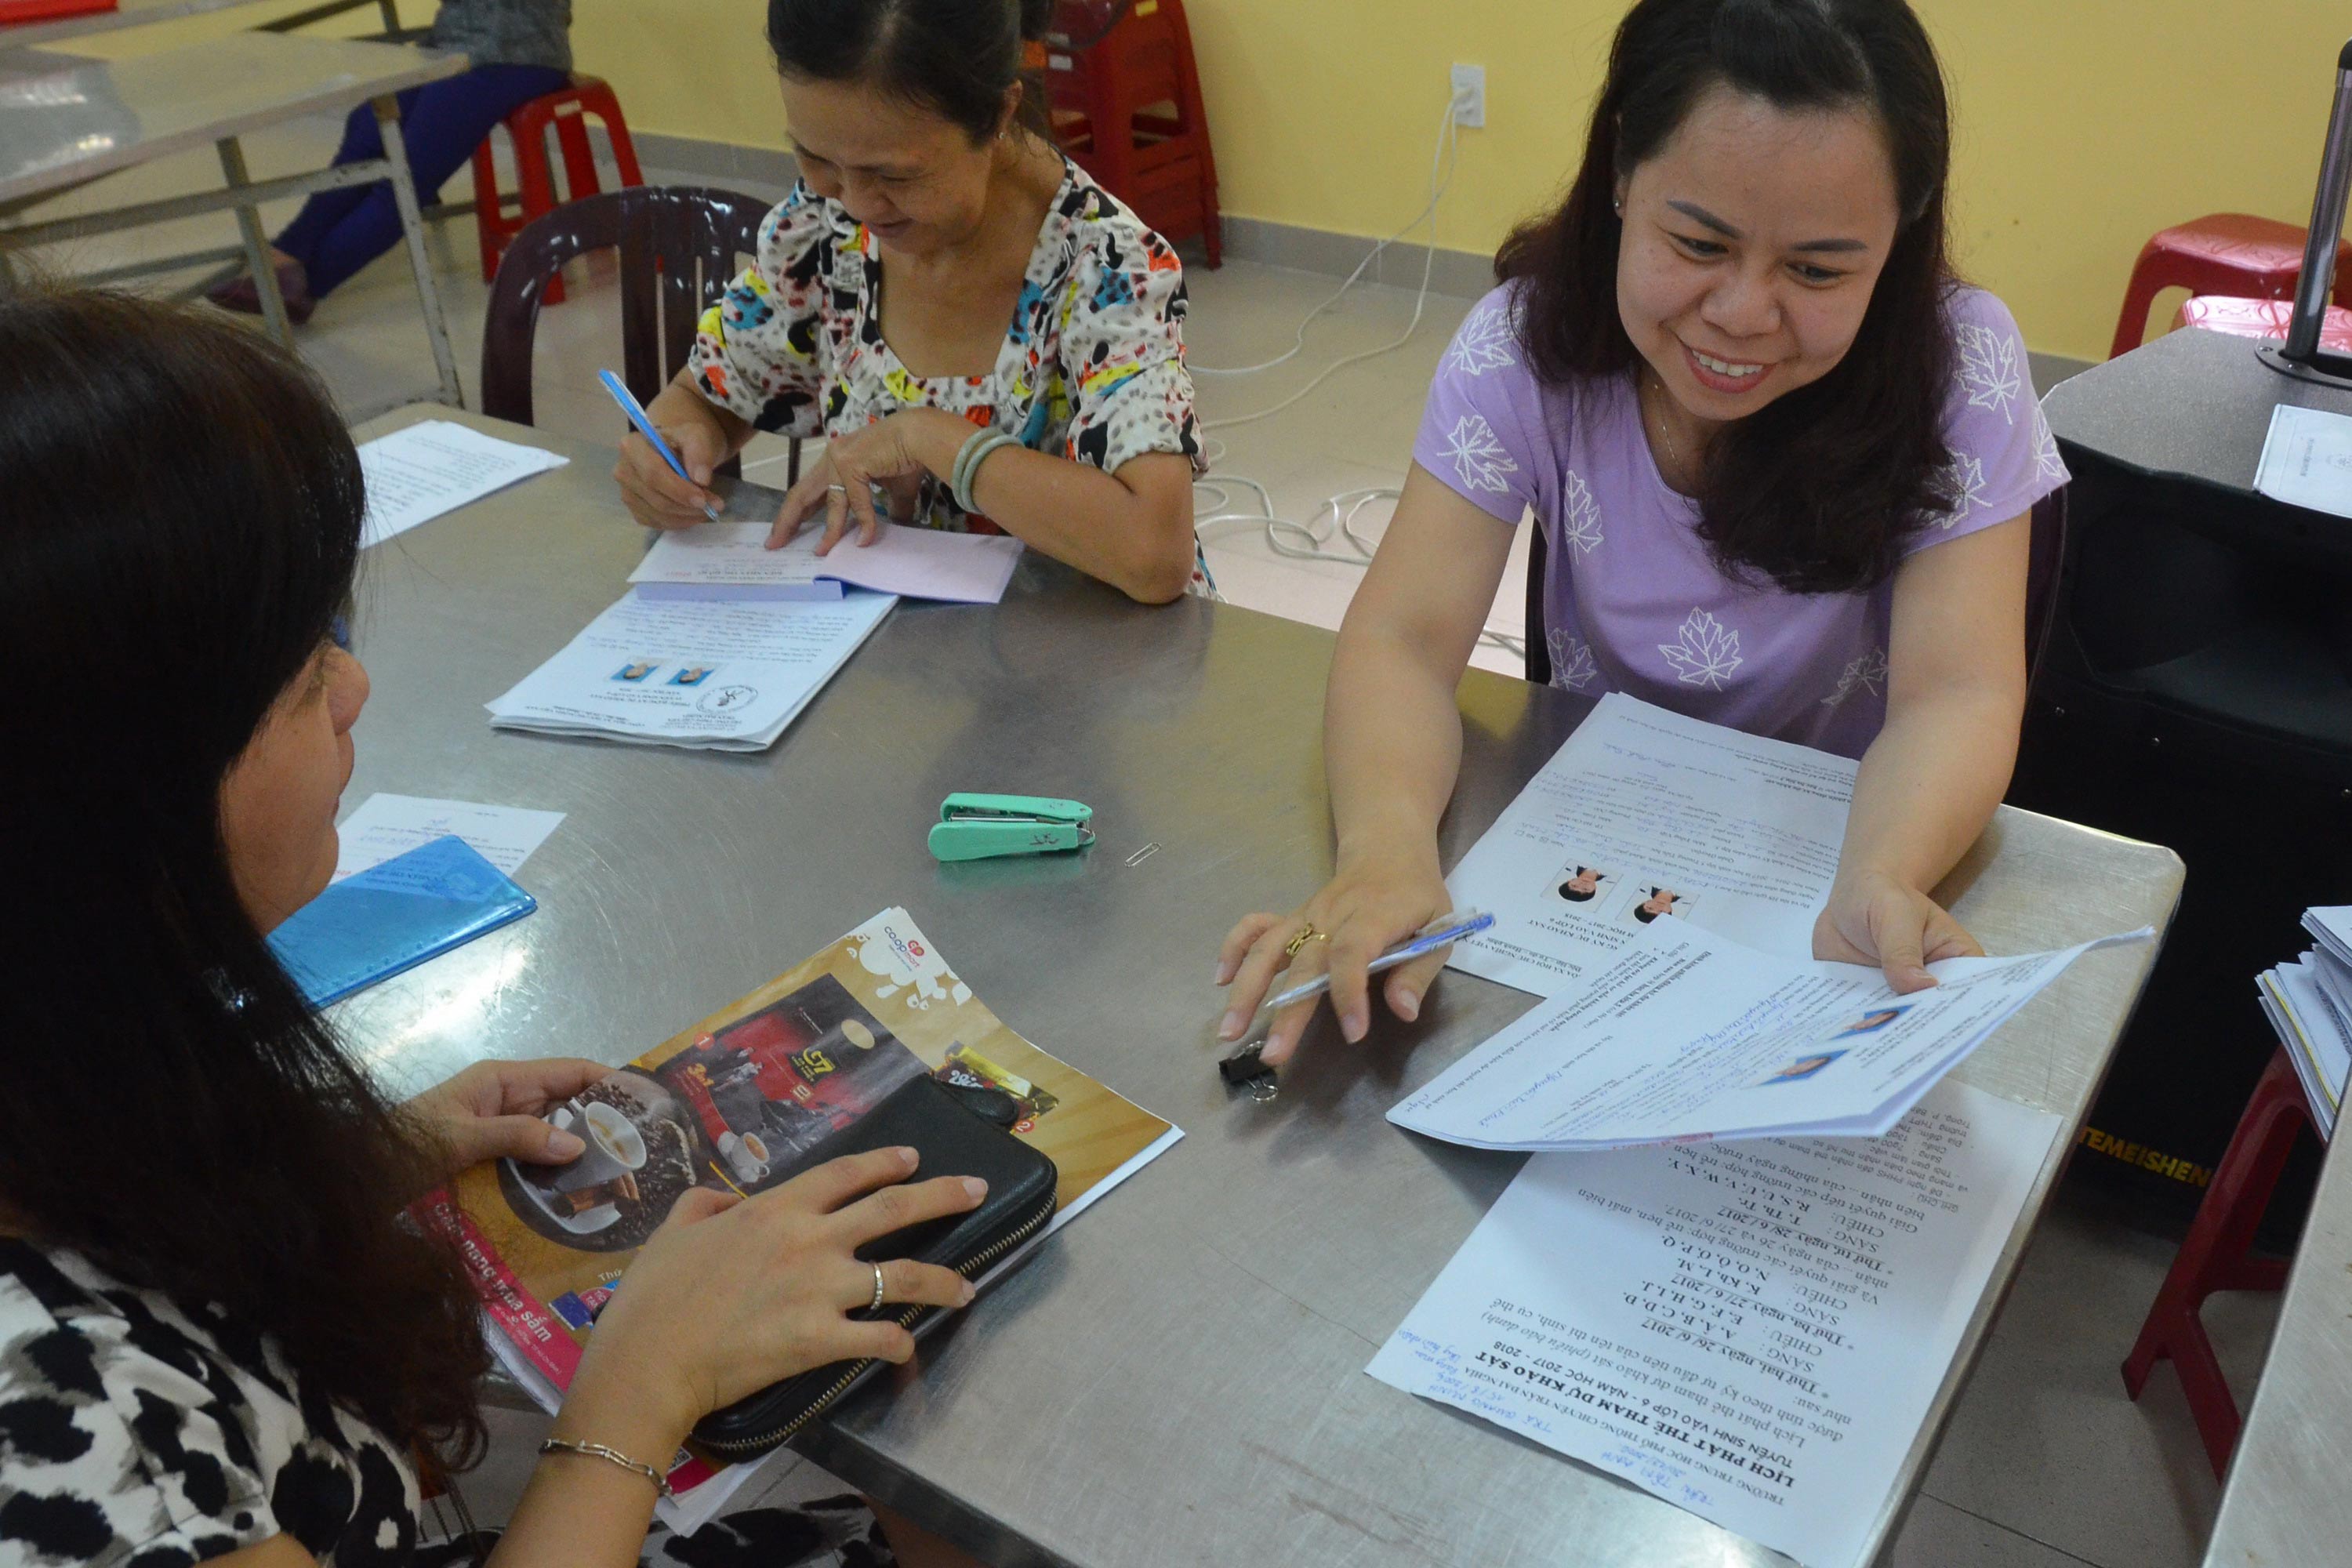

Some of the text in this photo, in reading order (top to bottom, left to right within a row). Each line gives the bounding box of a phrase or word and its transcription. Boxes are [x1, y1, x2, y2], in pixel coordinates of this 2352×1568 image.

[2078, 1126, 2213, 1188] TEMEISHEN
[1492, 1340, 1522, 1357] 2018
[1531, 1357, 1563, 1373] 2017
[1563, 1368, 1595, 1386] HỌC
[1595, 1380, 1628, 1399] NĂM
[1474, 1351, 1795, 1487] LỊCH PHÁT THẺ THAM DỰ KHẢO SÁT
[1651, 1403, 1679, 1419] LỚP
[1680, 1414, 1708, 1433] VÀO
[1712, 1428, 1746, 1448] SINH
[1747, 1442, 1792, 1468] TUYỂN
